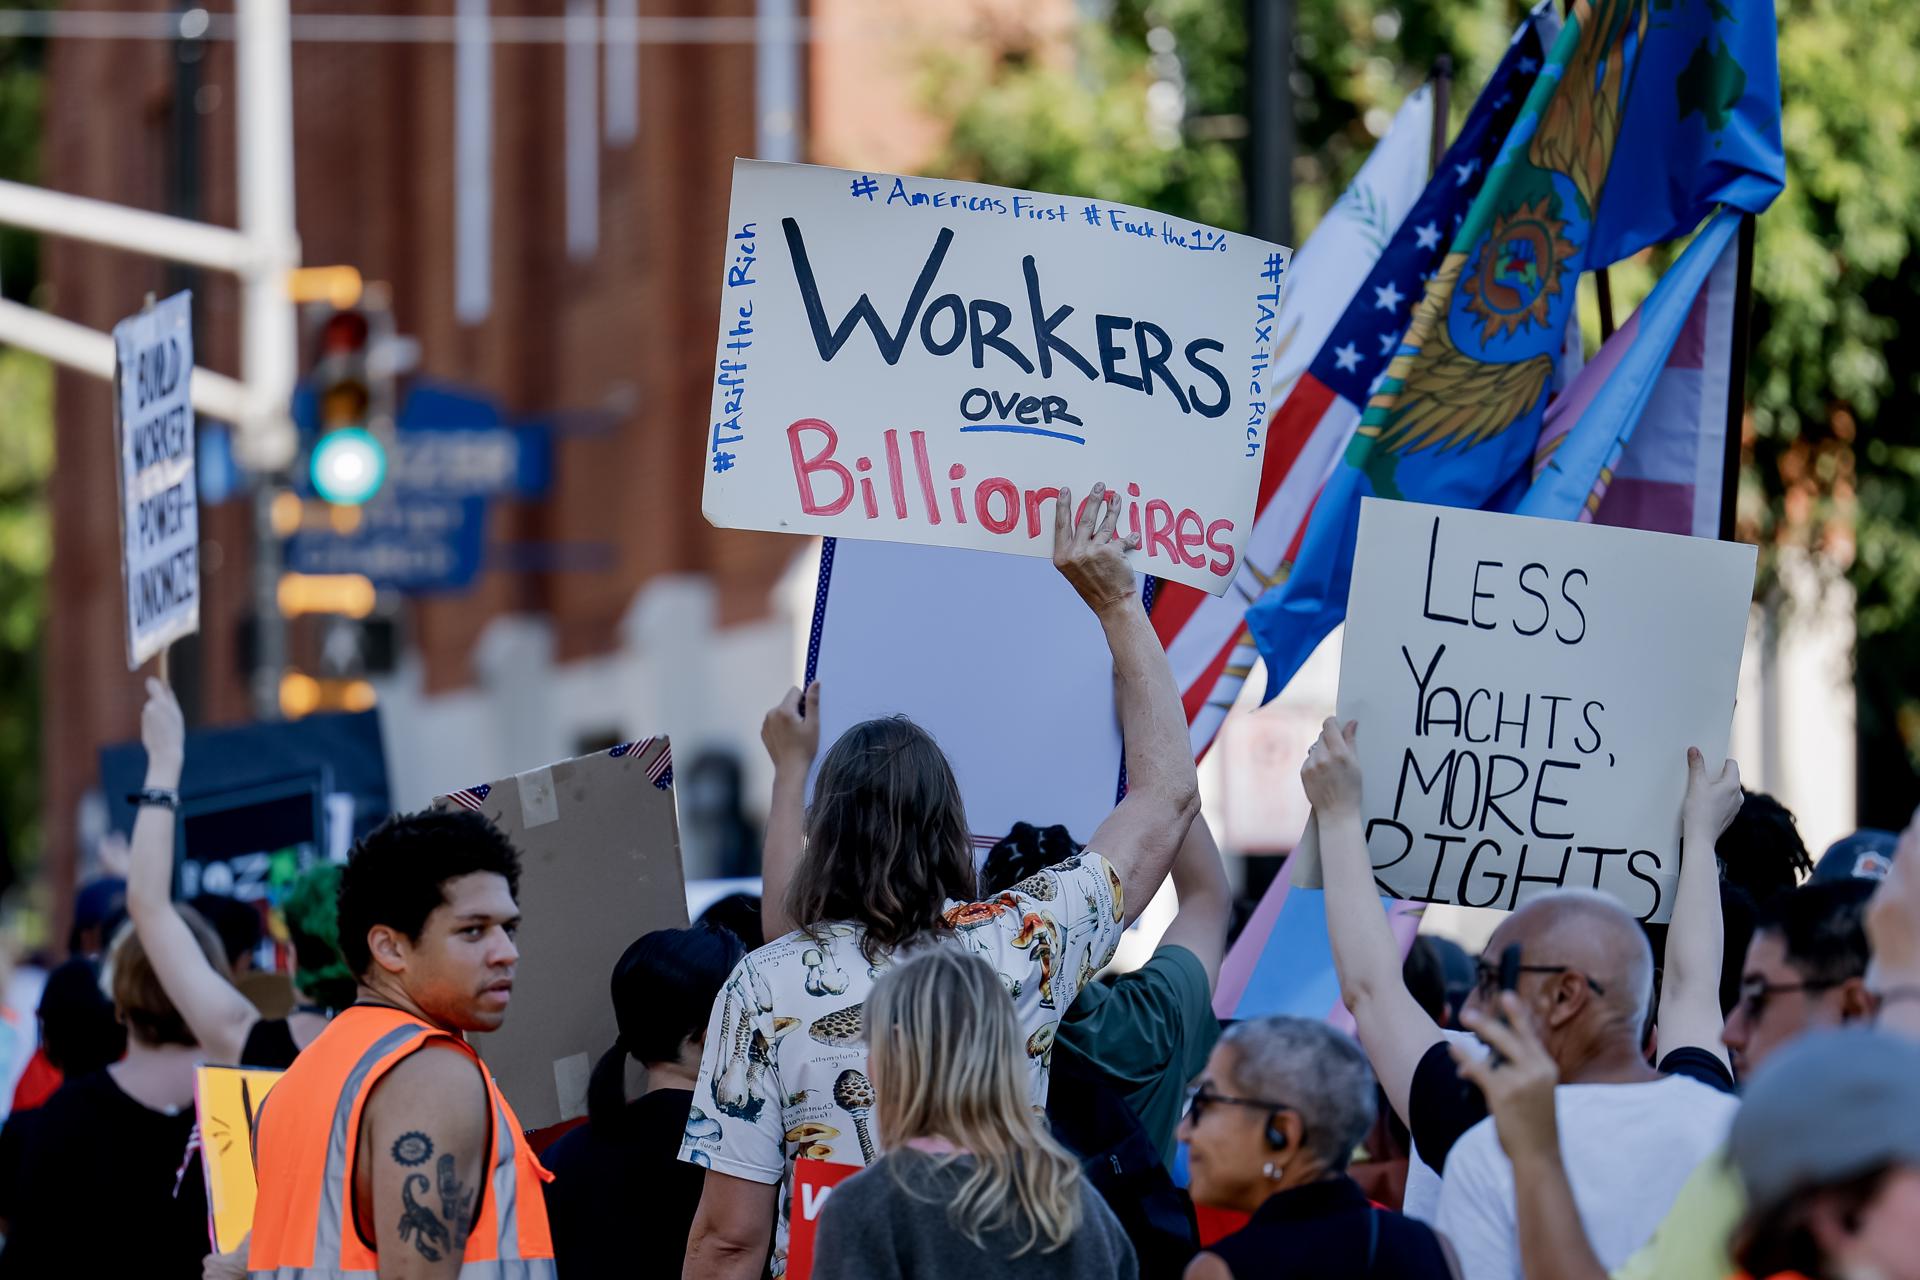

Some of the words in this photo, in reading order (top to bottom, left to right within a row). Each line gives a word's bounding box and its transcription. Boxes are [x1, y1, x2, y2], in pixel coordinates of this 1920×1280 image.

[727, 222, 757, 288] Rich
[1423, 516, 1588, 645] LESS
[1402, 644, 1615, 767] YACHTS,
[1393, 747, 1581, 840] MORE
